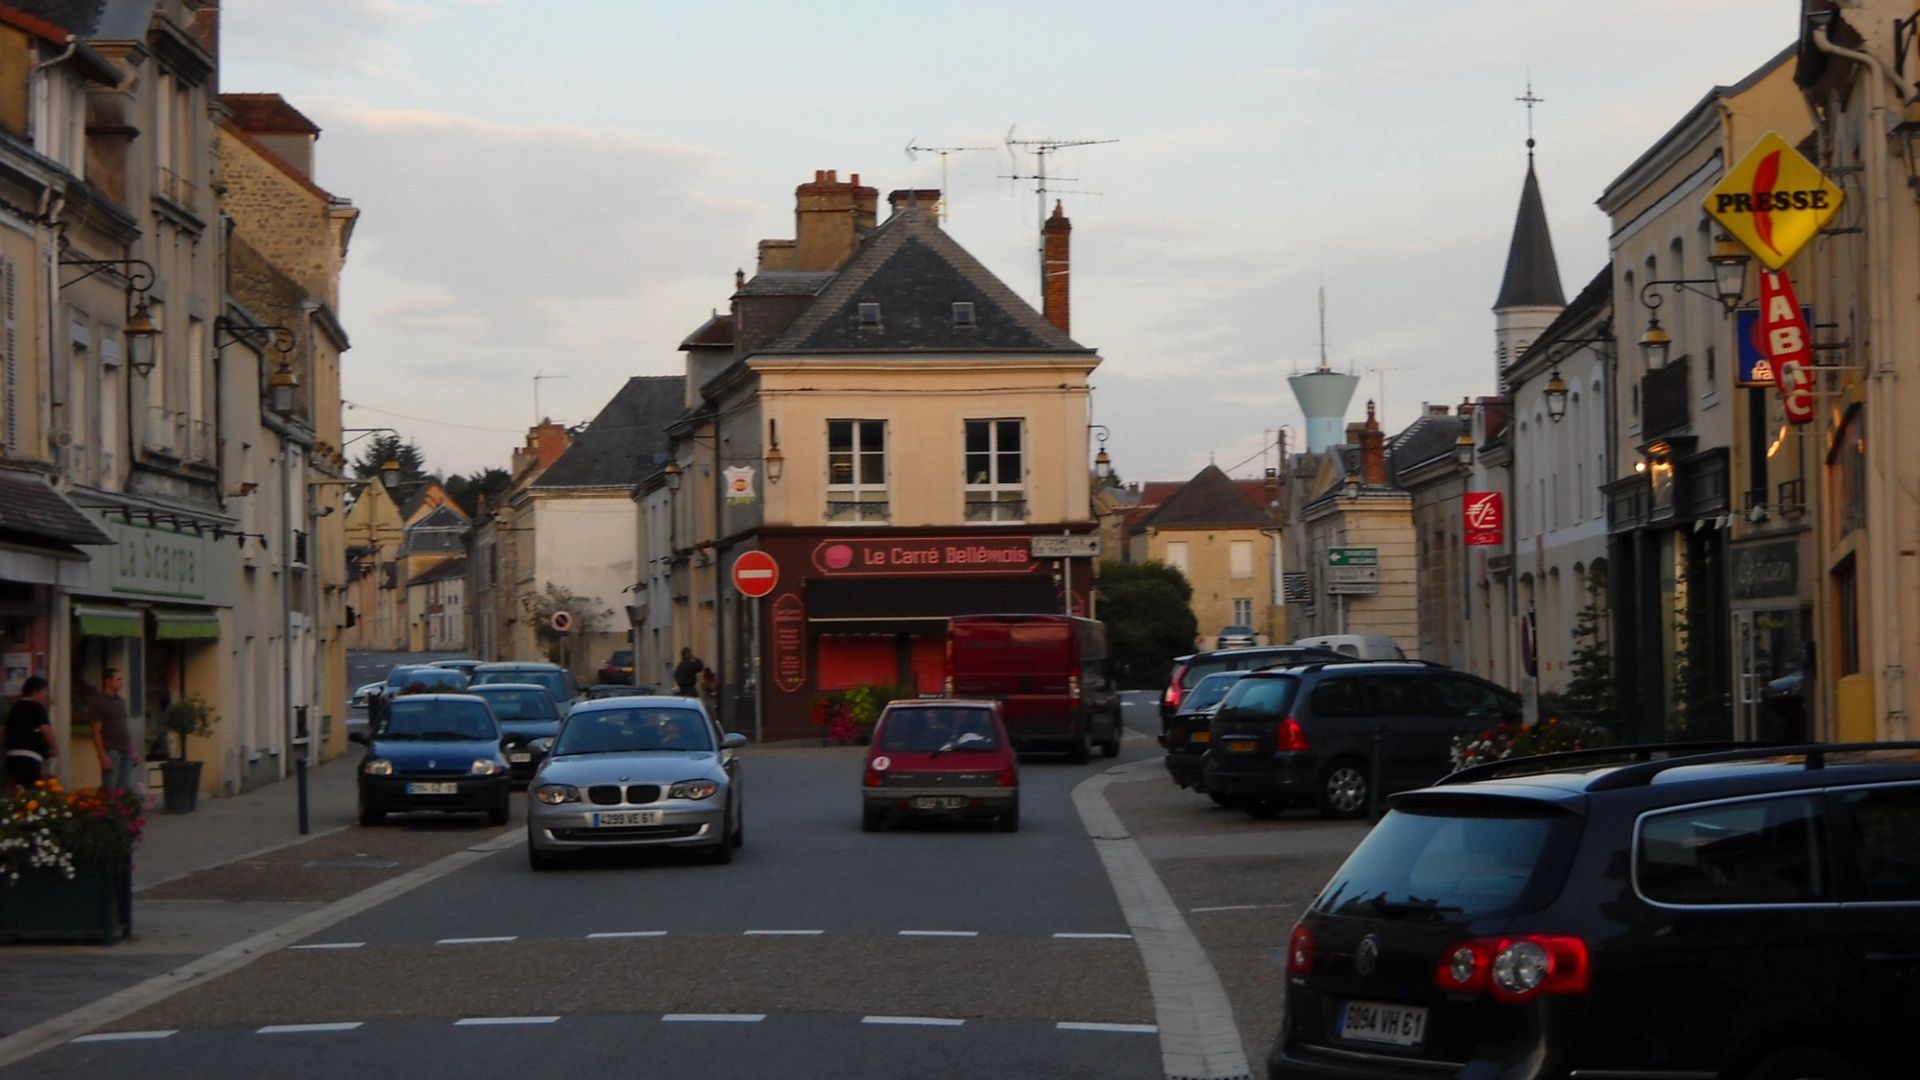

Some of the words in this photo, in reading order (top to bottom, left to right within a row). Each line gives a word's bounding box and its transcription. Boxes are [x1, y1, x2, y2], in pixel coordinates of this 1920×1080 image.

[1716, 190, 1828, 213] PRESSE
[119, 527, 136, 577] La
[143, 529, 196, 592] Scarpa
[864, 548, 886, 565] Le
[891, 546, 940, 564] Carré
[627, 813, 640, 824] VE
[641, 812, 655, 824] 61
[1381, 1010, 1401, 1034] VH
[1401, 1012, 1422, 1038] 61
